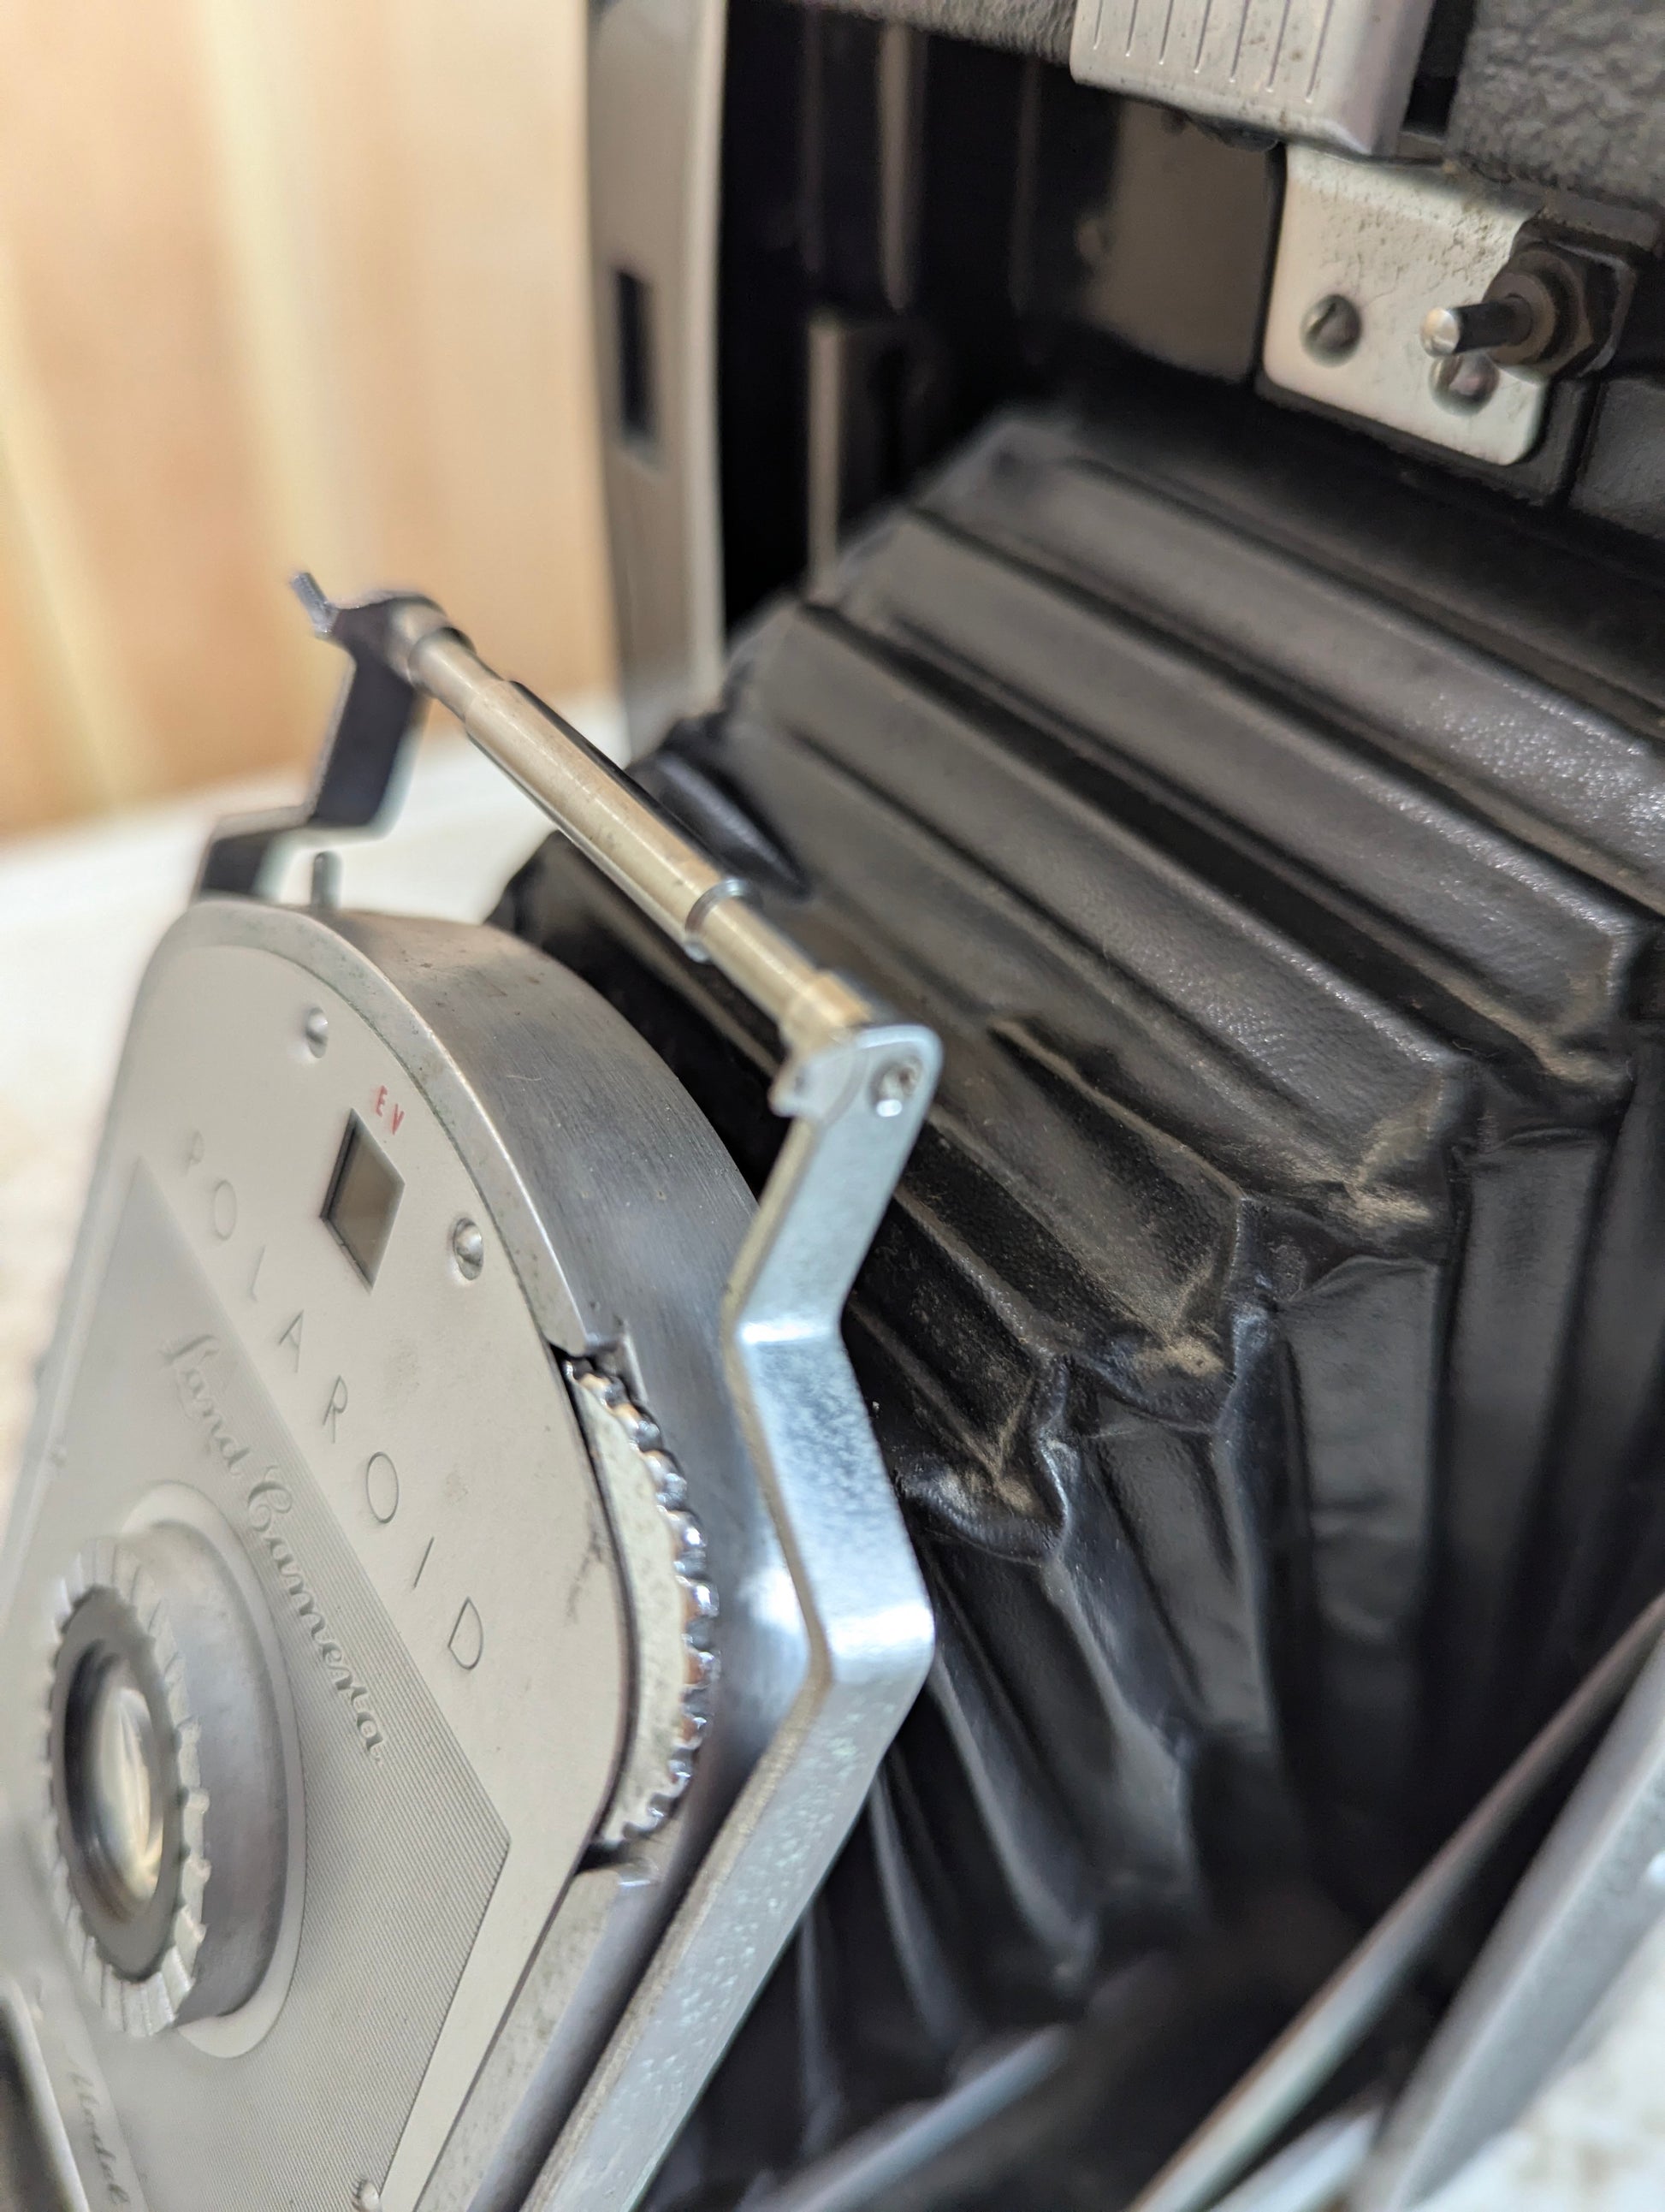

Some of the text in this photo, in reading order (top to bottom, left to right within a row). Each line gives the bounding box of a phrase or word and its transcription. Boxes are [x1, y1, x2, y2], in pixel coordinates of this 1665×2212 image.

[375, 1085, 405, 1136] EV
[180, 1129, 484, 1670] POLAROID
[247, 1465, 384, 1763] Camera
